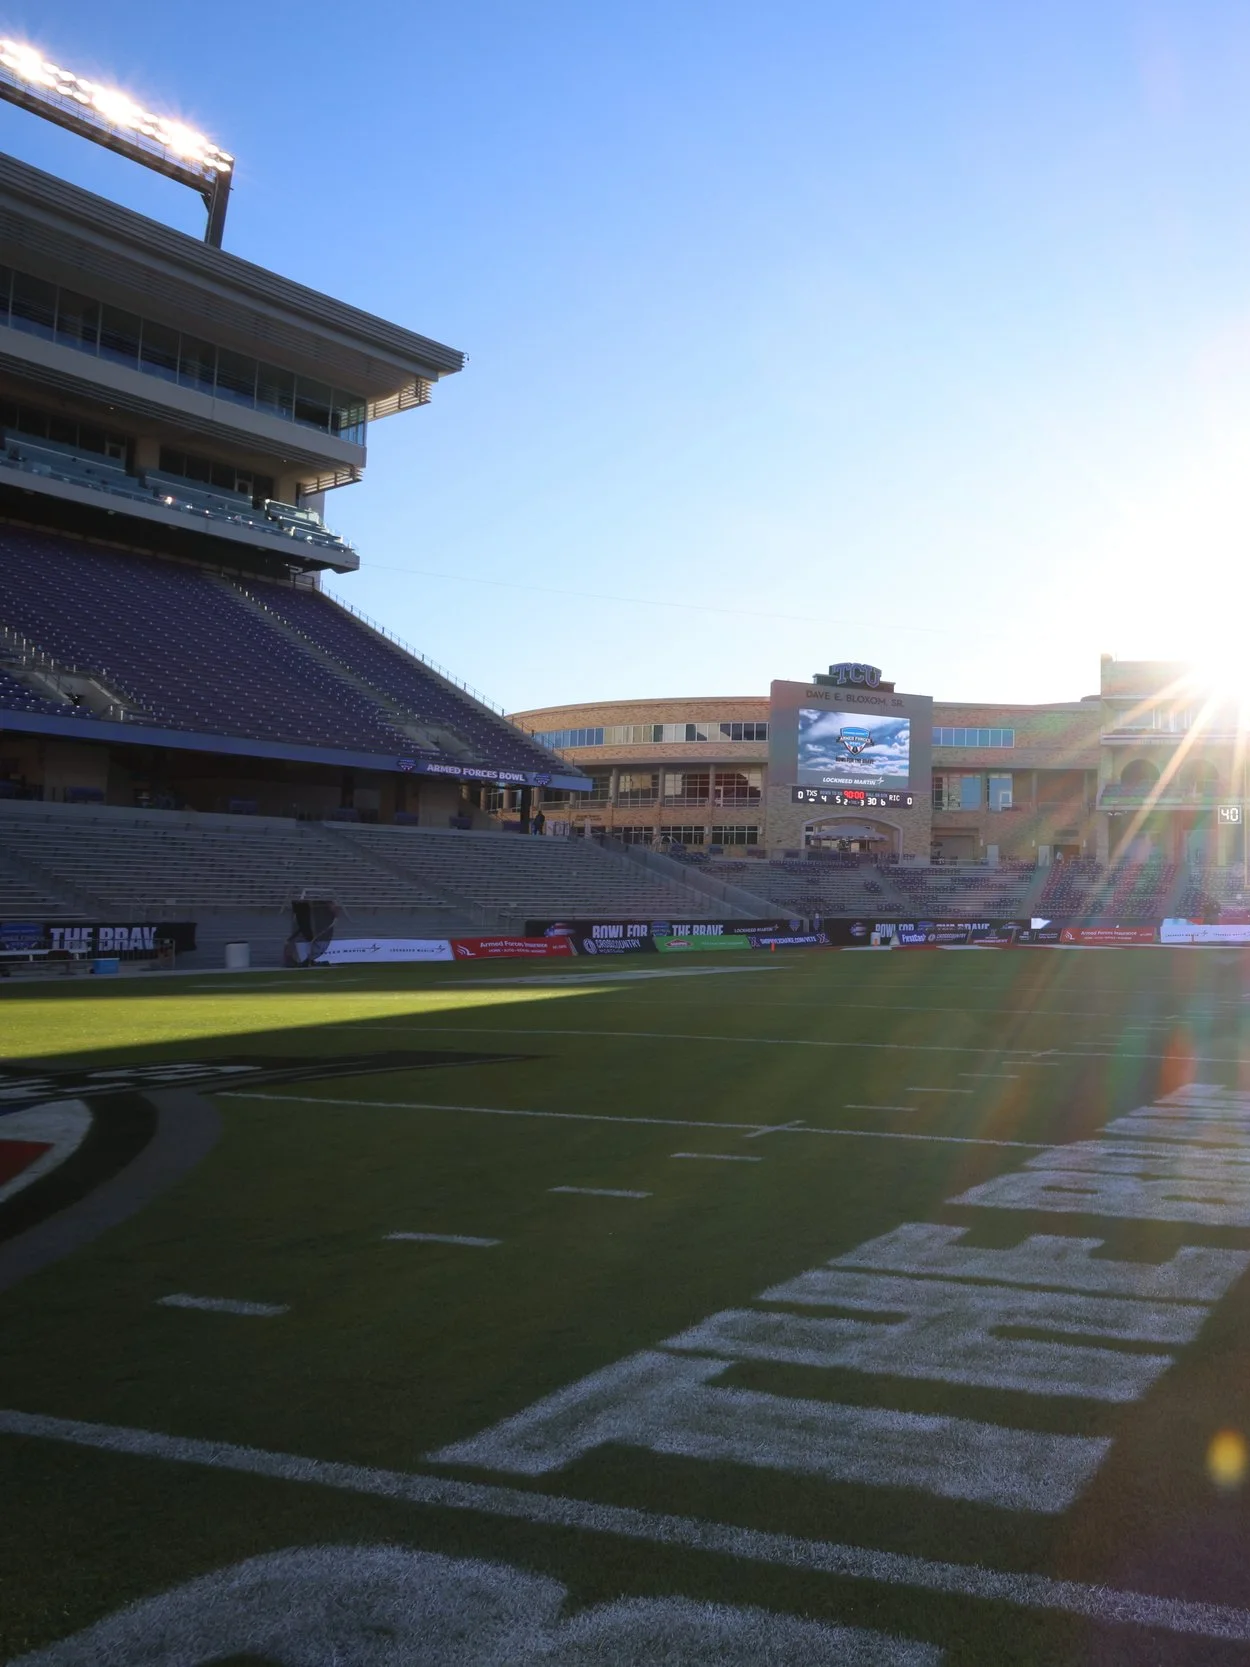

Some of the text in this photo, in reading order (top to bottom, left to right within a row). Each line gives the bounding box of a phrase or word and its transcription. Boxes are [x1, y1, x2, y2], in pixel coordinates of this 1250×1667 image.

[832, 662, 881, 688] TCU
[806, 690, 830, 700] DAVE
[427, 763, 460, 775] ARMED
[462, 767, 497, 779] FORCES
[499, 772, 525, 781] BOWL
[798, 791, 803, 799] 0
[821, 795, 827, 803] 4
[843, 790, 865, 799] 90:00
[867, 798, 876, 806] 30
[907, 797, 912, 805] 0
[1220, 807, 1239, 821] 40
[672, 924, 691, 936] THE
[692, 924, 724, 936] BRAVE
[51, 927, 94, 950] THE
[98, 927, 157, 950] BRAV
